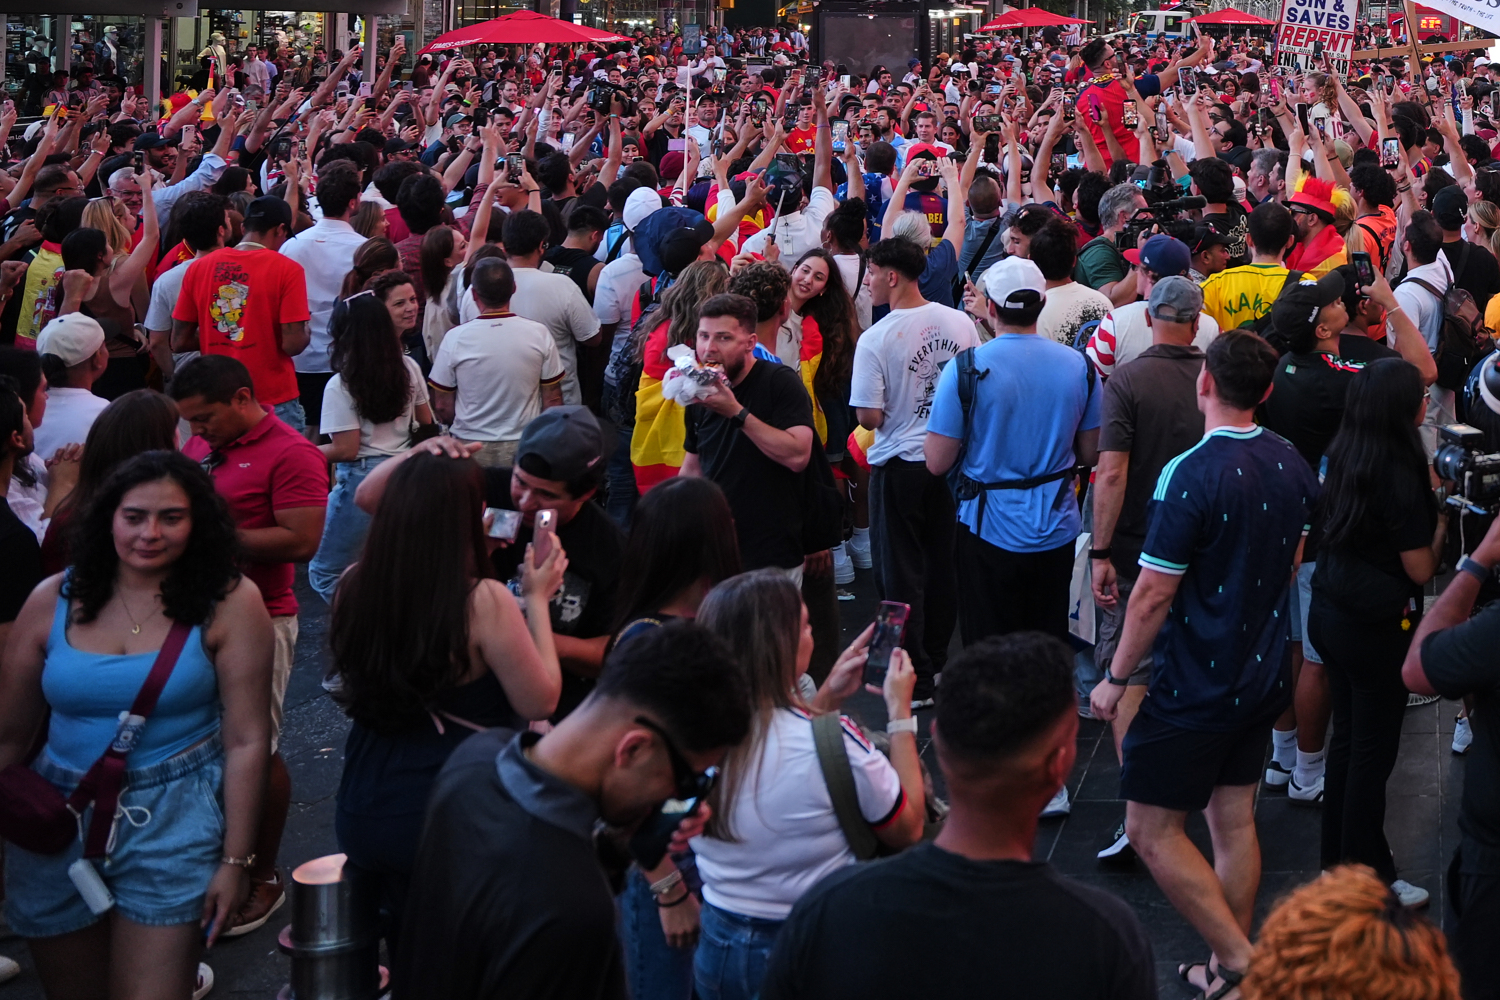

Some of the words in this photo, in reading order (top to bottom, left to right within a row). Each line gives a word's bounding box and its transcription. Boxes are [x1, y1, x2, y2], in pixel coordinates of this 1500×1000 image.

[1286, 7, 1350, 30] SAVES
[1459, 2, 1474, 13] TRUTH
[1476, 10, 1484, 19] THE
[1280, 25, 1353, 53] REPENT
[1279, 45, 1296, 54] TURN
[1278, 52, 1298, 68] END
[1304, 55, 1316, 70] IS
[908, 338, 961, 373] EVERYTHIN
